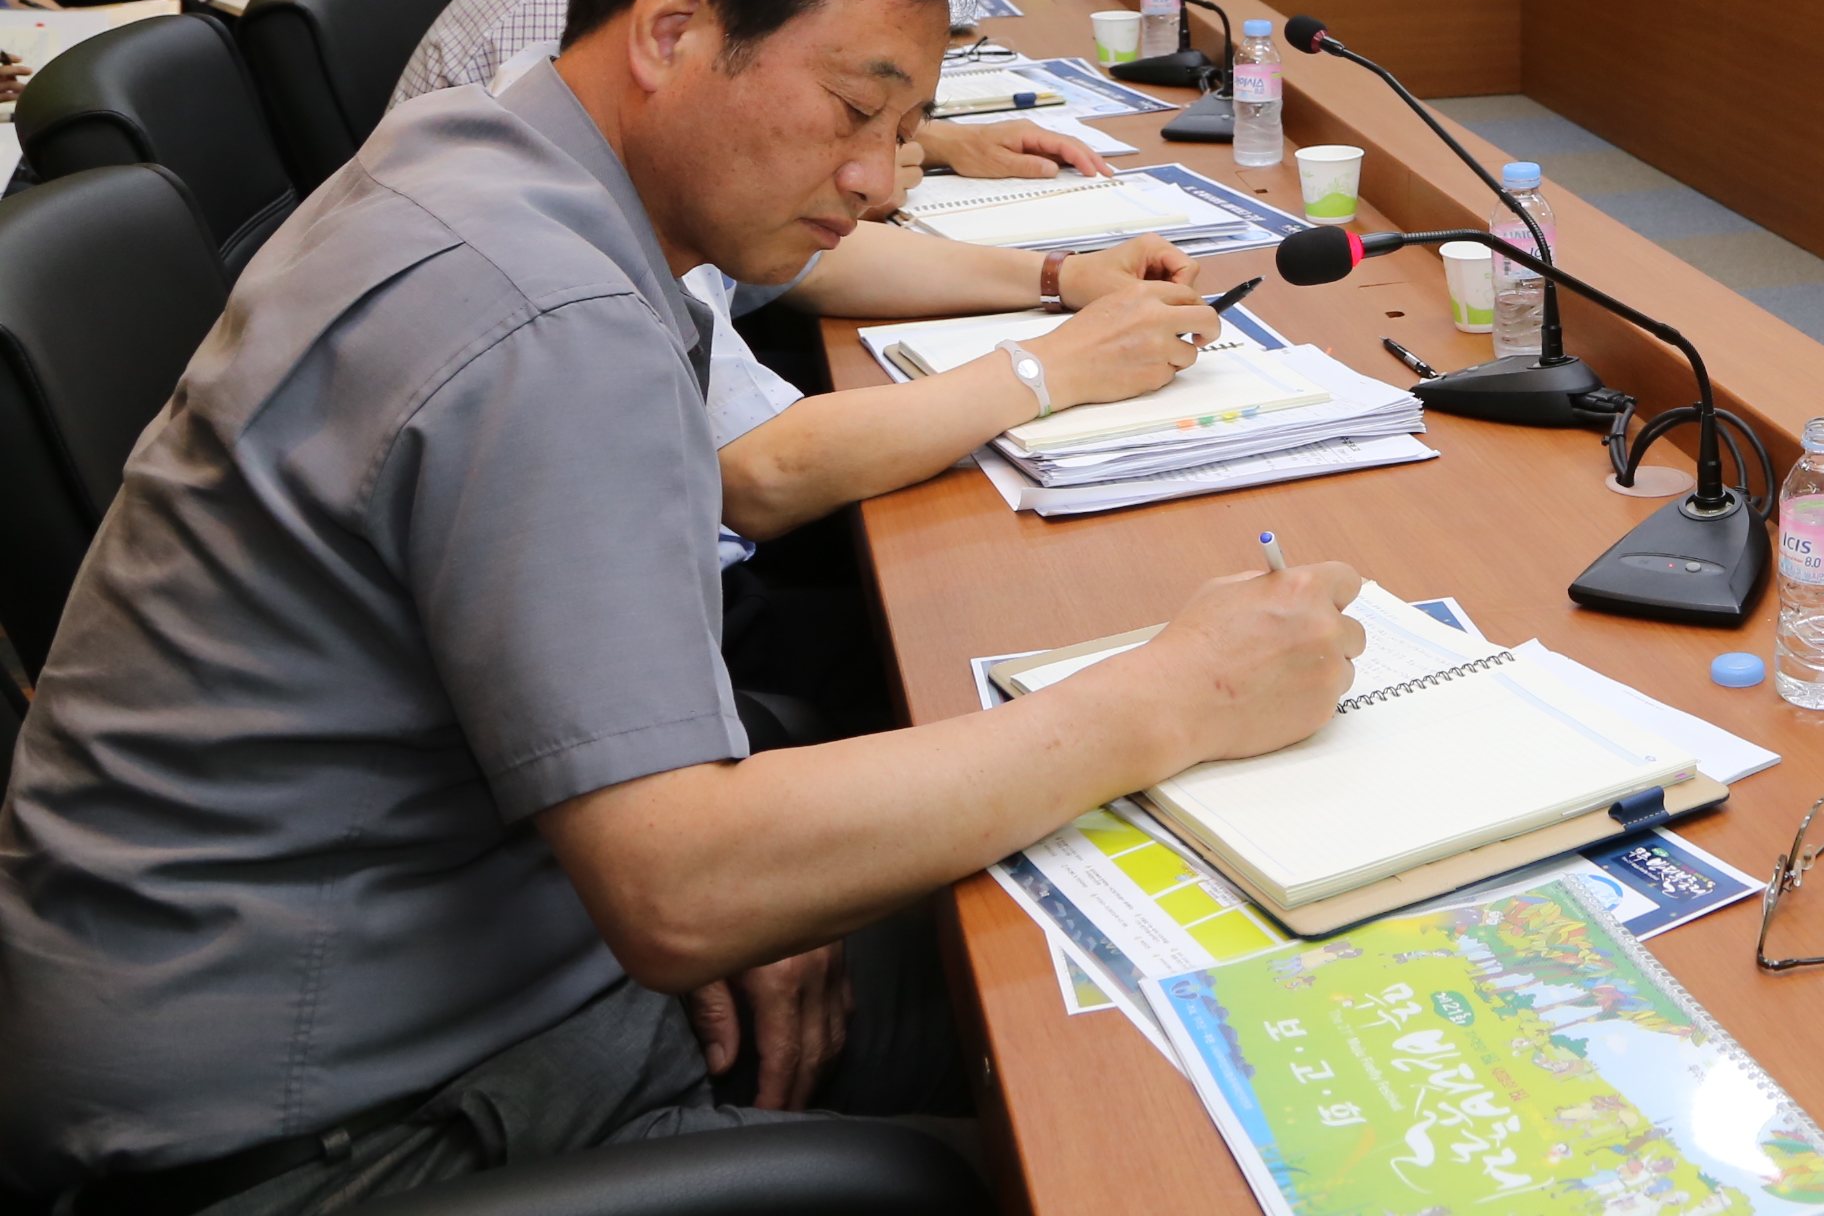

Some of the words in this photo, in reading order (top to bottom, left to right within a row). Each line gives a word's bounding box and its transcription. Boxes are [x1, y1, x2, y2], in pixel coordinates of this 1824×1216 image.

[1783, 531, 1812, 554] ICIS
[1804, 556, 1821, 568] 8.0
[1436, 992, 1471, 1024] 제21회
[1355, 982, 1422, 1031] 무주
[1390, 1029, 1554, 1205] 반딧불축제
